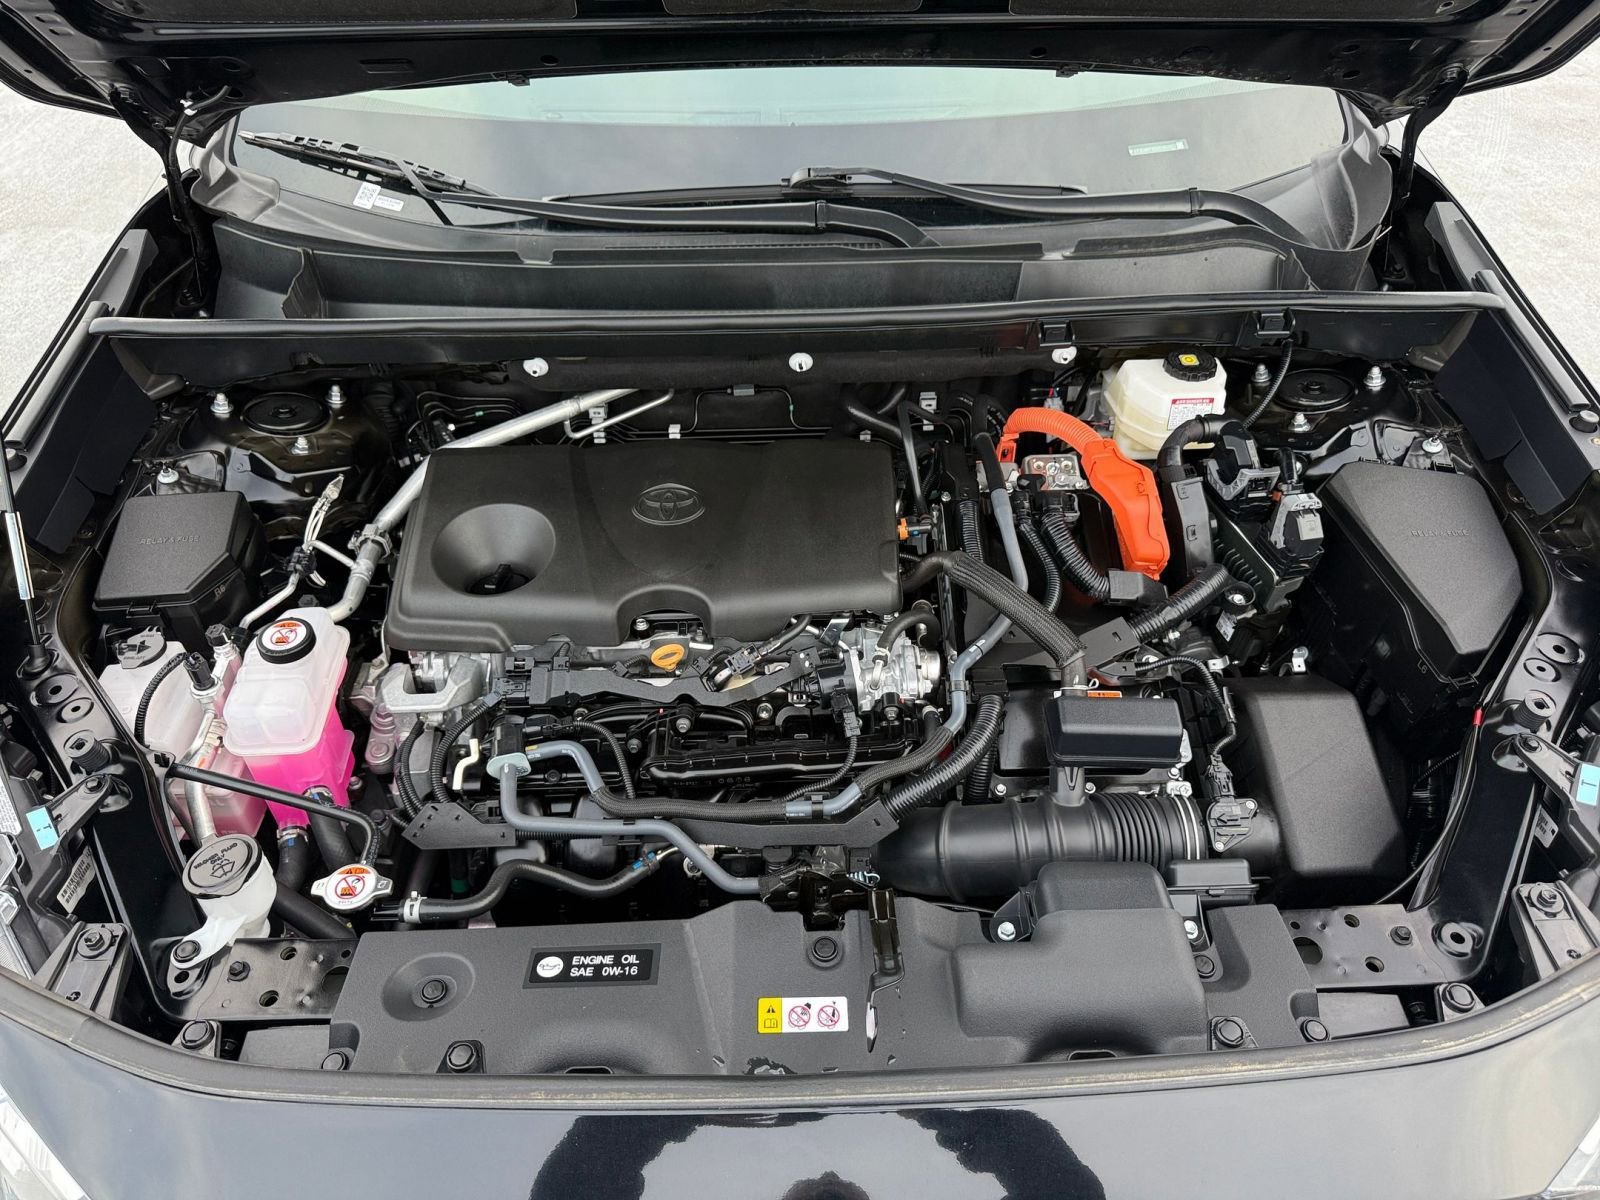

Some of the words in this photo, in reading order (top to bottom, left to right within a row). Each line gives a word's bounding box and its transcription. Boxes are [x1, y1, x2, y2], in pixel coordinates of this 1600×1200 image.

[572, 955, 614, 966] ENGINE
[621, 954, 640, 964] OIL
[569, 966, 594, 977] SAE
[601, 966, 638, 977] 0W-16
